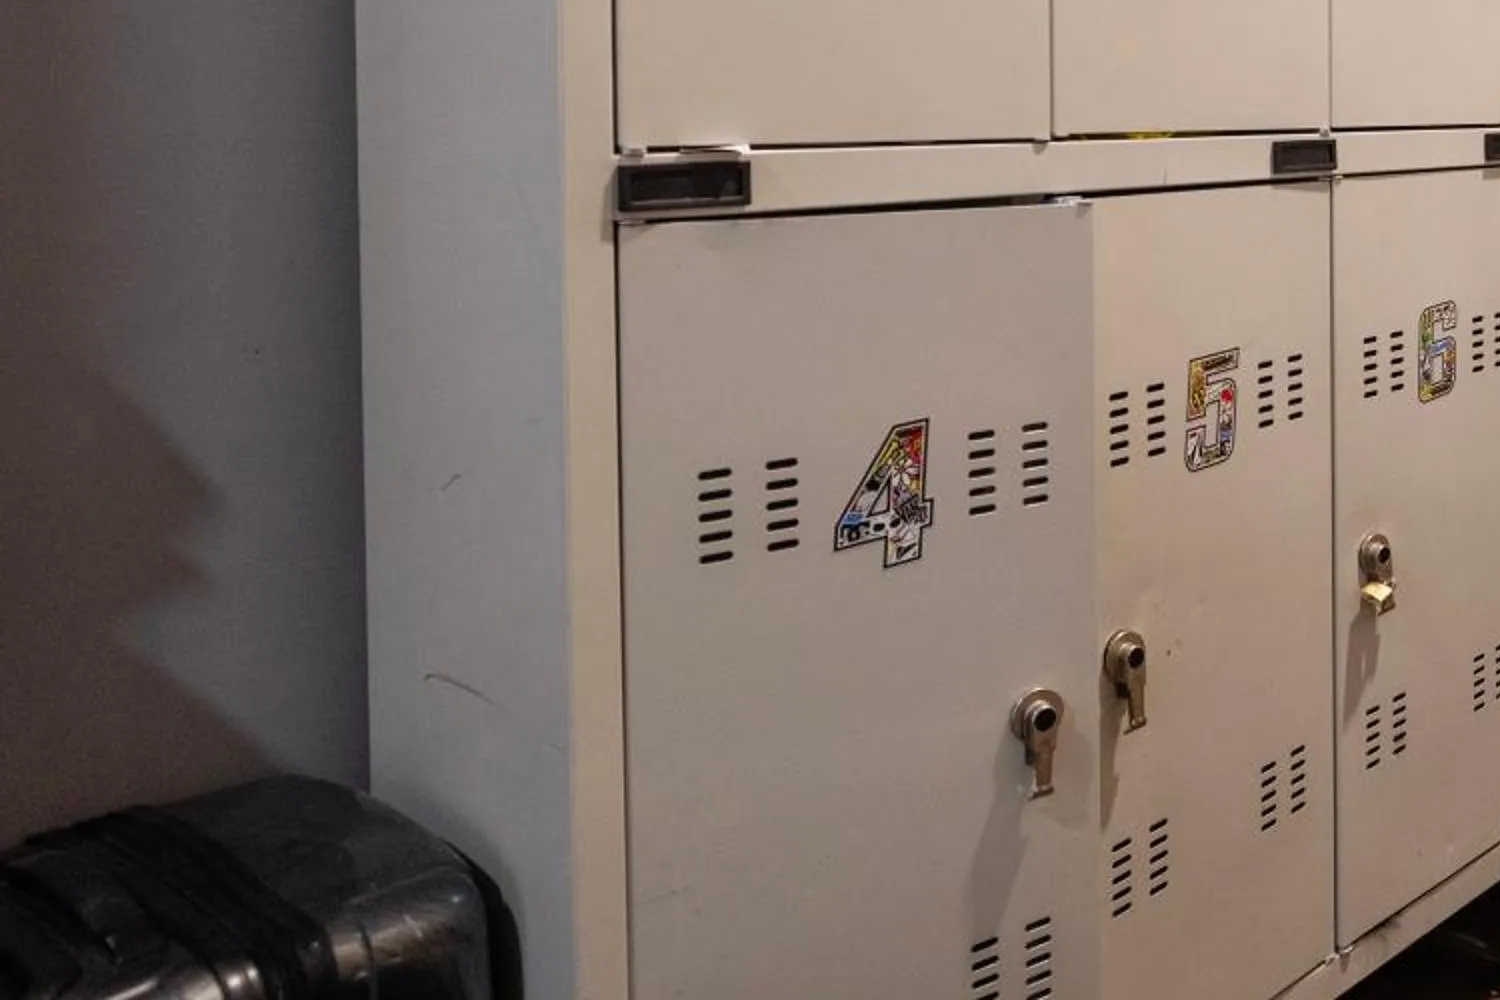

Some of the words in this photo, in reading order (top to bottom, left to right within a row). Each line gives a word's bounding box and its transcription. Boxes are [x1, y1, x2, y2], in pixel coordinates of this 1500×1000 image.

[1184, 347, 1240, 472] 5
[1418, 300, 1457, 404] 6
[834, 418, 934, 568] 4
